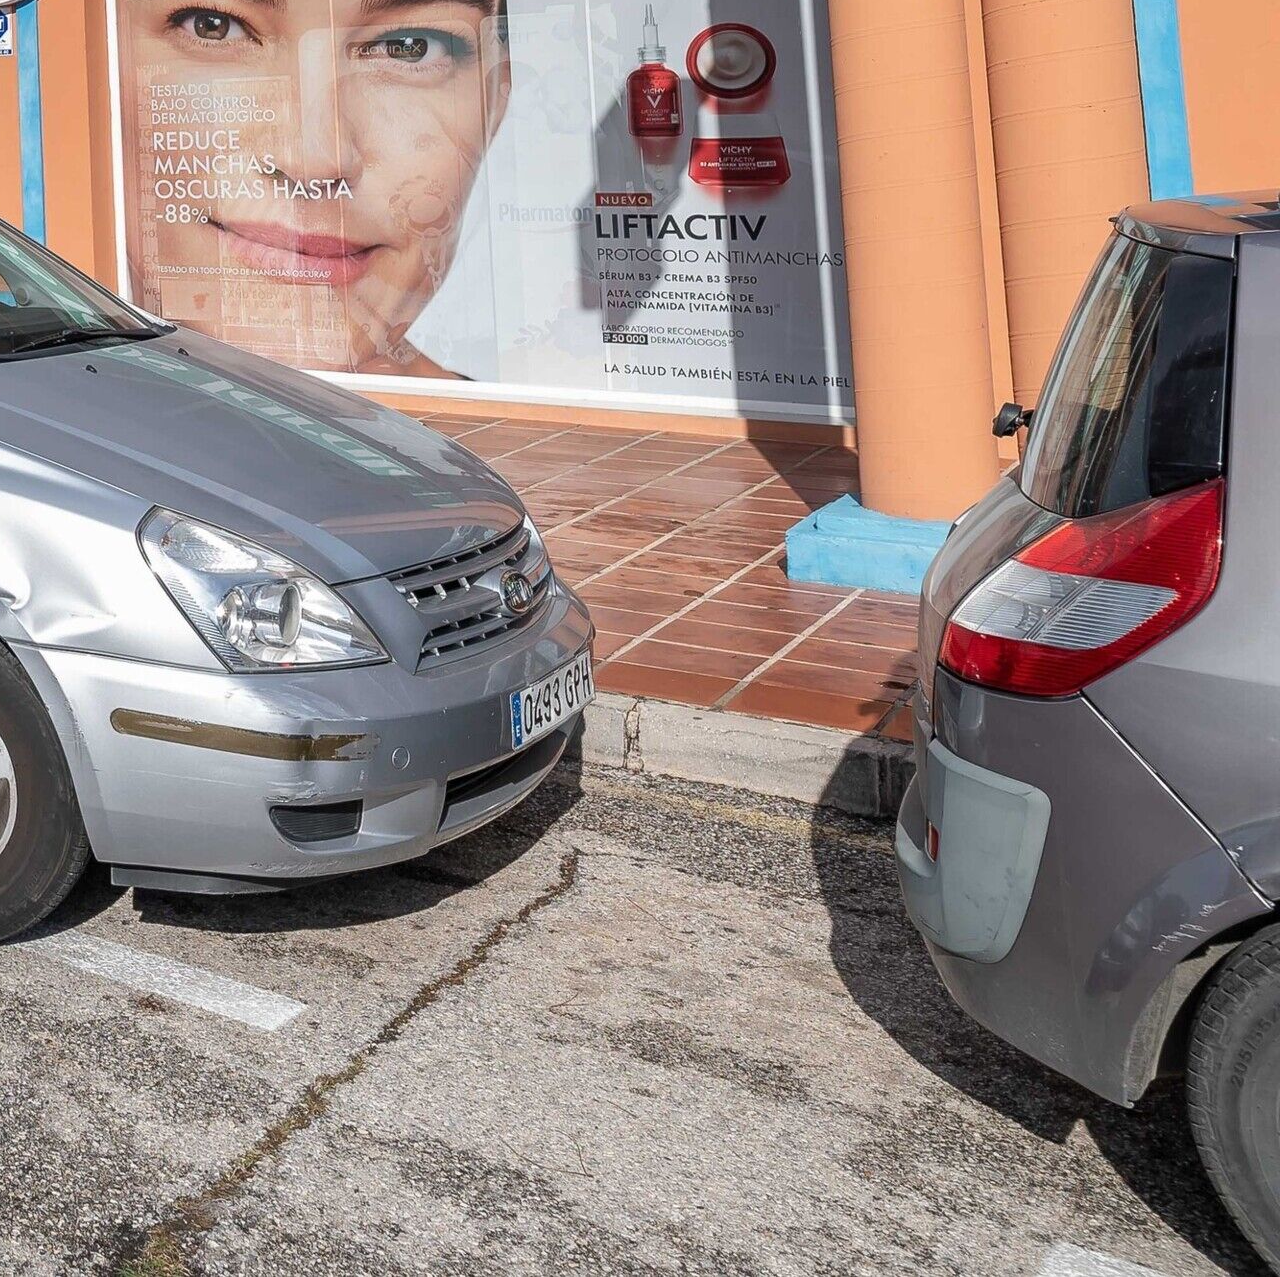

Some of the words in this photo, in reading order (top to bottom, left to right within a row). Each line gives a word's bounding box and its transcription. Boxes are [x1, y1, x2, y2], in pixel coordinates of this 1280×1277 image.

[149, 83, 210, 97] TESTADO
[151, 97, 187, 111] BAJO
[190, 96, 259, 111] CONTROL
[151, 108, 276, 125] DERMATOLÓGICO
[153, 129, 240, 151] REDUCE
[720, 146, 752, 154] VICHY
[154, 154, 277, 175] MANCHAS
[154, 179, 265, 199] OSCURAS
[273, 178, 354, 200] HASTA
[600, 195, 648, 205] NUEVO
[499, 203, 592, 223] Pharmaton
[595, 213, 768, 242] LIFTACTIV
[597, 248, 699, 263] PROTOCOLO
[704, 249, 844, 266] ANTIMANCHAS
[157, 265, 188, 274] TESTADO
[189, 266, 199, 274] EN
[200, 267, 220, 275] TODO
[221, 267, 239, 275] TIPO
[240, 268, 251, 276] DE
[252, 269, 291, 278] MANCHAS
[598, 270, 636, 281] SÉRUM
[638, 273, 652, 282] B3
[664, 274, 703, 283] CREMA
[706, 275, 721, 284] B3
[724, 275, 758, 284] SPF50
[606, 289, 632, 299] ALTA
[634, 289, 737, 302] CONCENTRACIÓN
[739, 293, 755, 303] DE
[607, 299, 686, 311] NIACINAMIDA
[602, 324, 665, 335] LABORATORIO
[667, 326, 745, 339] RECOMENDADO
[611, 333, 626, 343] 50
[604, 363, 620, 374] LA
[624, 364, 667, 376] SALUD
[670, 366, 733, 381] TAMBIÉN
[737, 369, 770, 383] ESTÁ
[775, 373, 795, 384] EN
[800, 375, 818, 386] LA
[823, 375, 852, 388] PIEL
[524, 677, 561, 734] 0493
[564, 657, 591, 709] GPH
